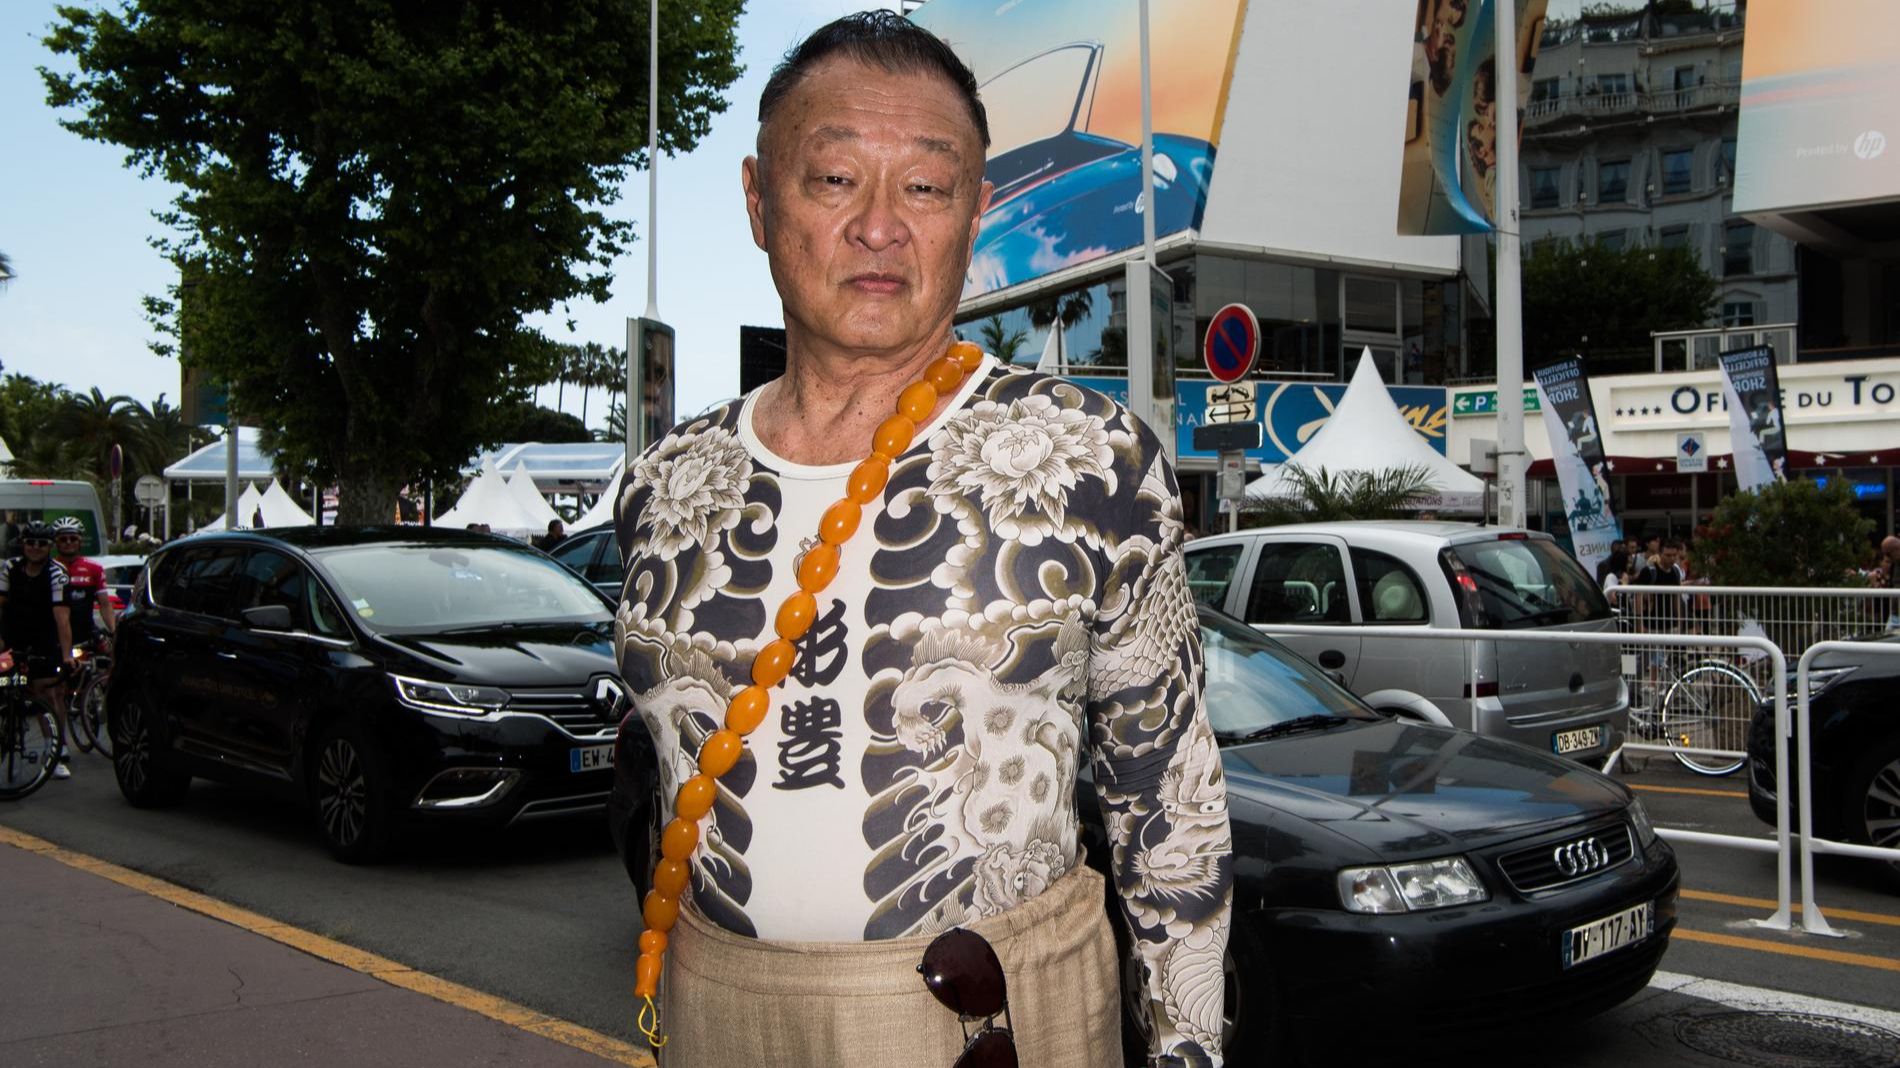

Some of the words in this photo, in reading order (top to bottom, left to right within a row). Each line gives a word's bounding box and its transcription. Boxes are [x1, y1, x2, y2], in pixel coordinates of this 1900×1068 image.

[1856, 131, 1885, 159] hp
[1475, 396, 1487, 411] P
[1798, 391, 1832, 408] DU
